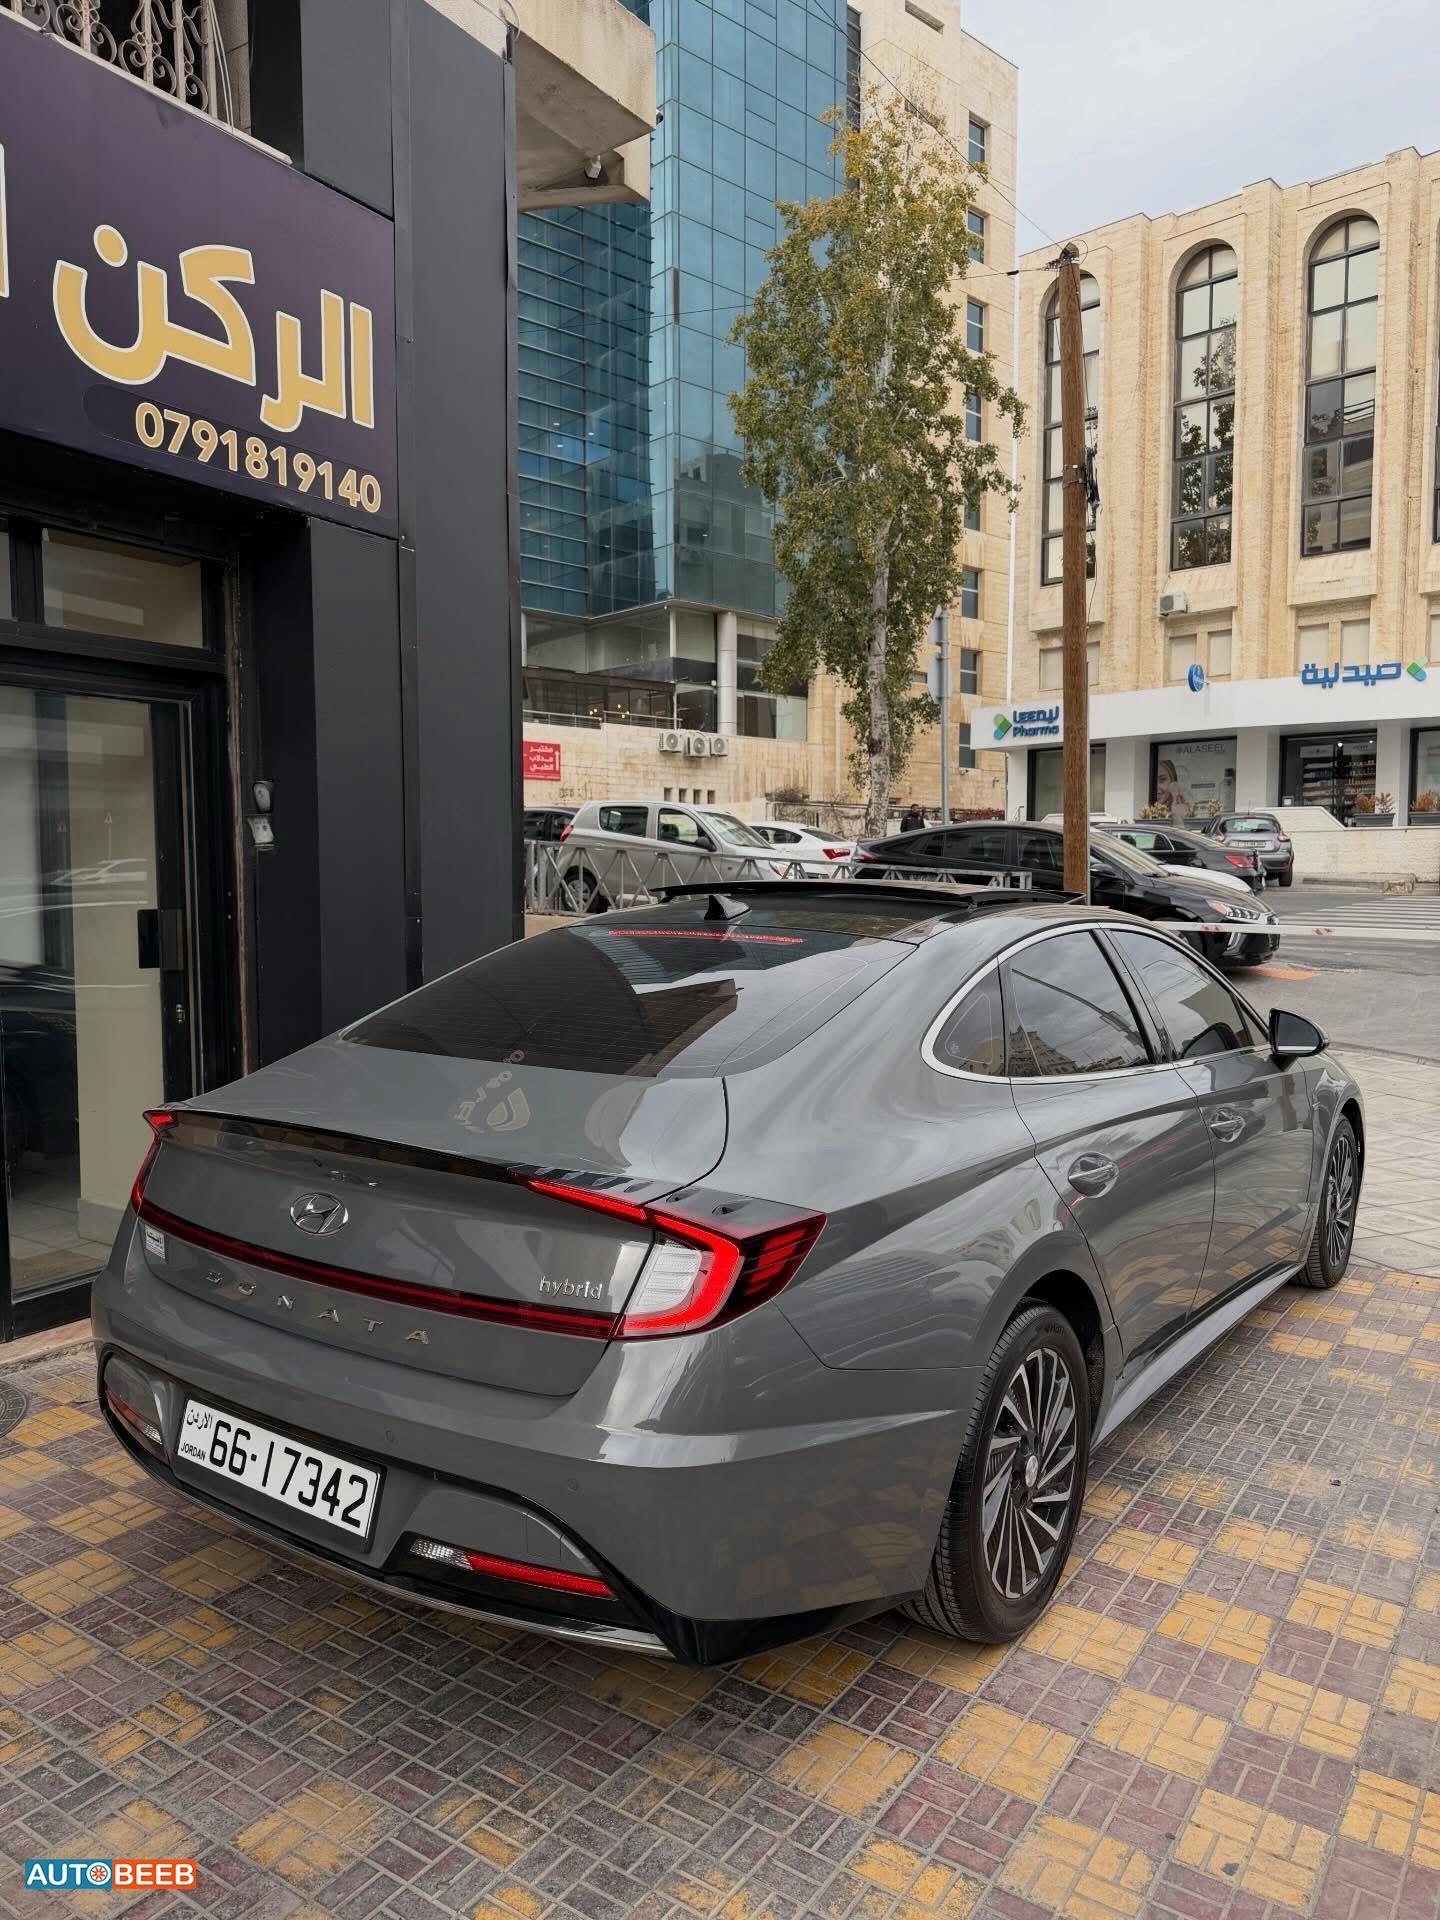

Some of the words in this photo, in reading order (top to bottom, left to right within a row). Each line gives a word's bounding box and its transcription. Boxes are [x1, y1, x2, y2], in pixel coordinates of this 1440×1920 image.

[53, 224, 375, 433] الركن
[135, 401, 382, 514] 0791819140
[1301, 662, 1401, 689] صيدلية
[1013, 725, 1060, 737] Pharma
[539, 1275, 603, 1300] hybrid
[206, 1270, 432, 1345] SONATA
[181, 1442, 207, 1461] JORDAN
